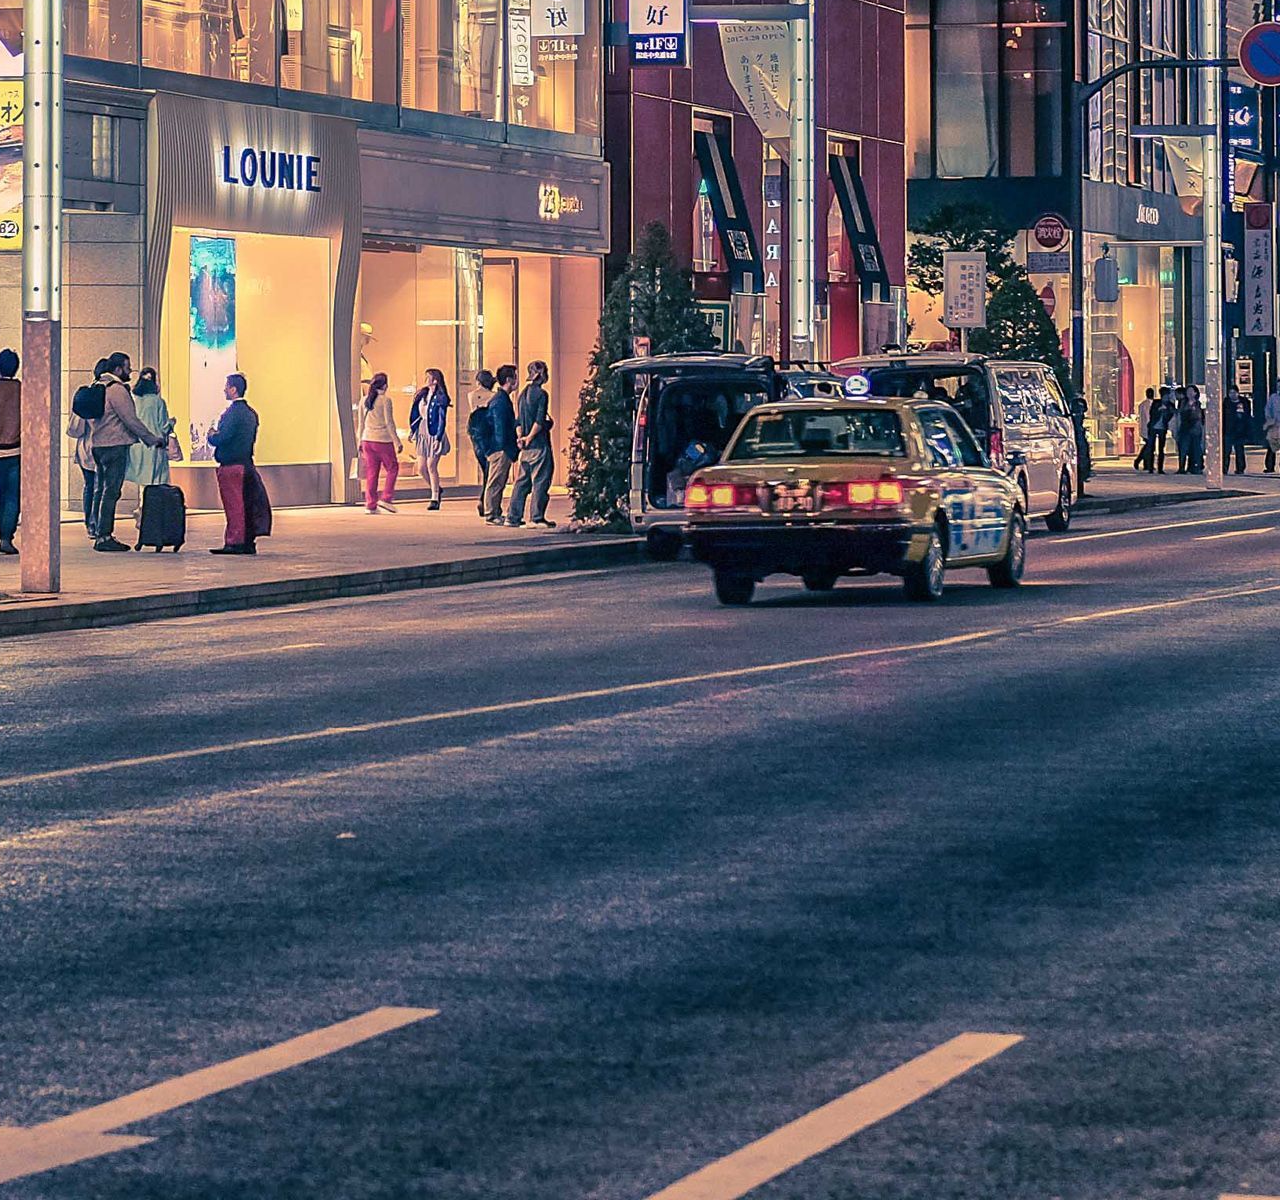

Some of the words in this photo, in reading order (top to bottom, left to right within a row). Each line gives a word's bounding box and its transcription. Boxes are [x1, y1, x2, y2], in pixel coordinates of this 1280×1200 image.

[725, 24, 762, 33] GINZA
[222, 145, 321, 193] LOUNIE
[0, 223, 16, 234] B2
